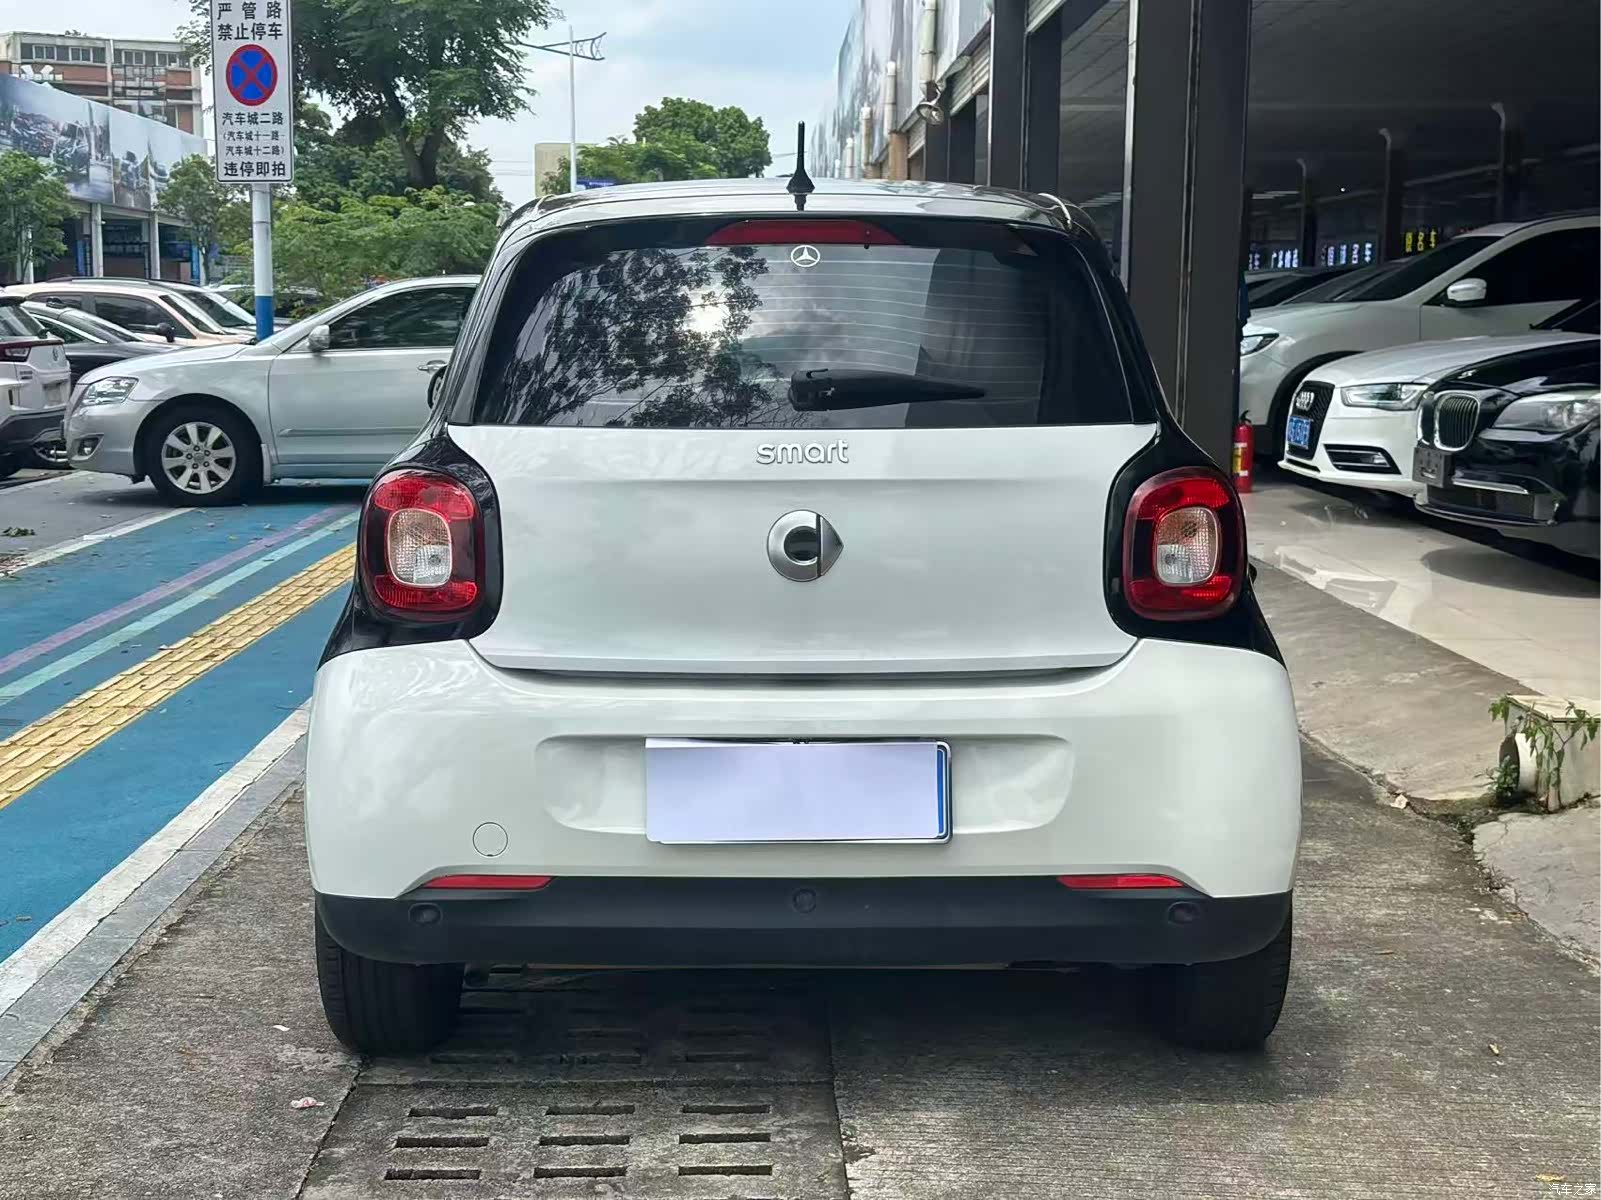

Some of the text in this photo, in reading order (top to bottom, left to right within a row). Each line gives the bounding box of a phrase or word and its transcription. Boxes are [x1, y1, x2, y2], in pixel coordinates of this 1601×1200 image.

[217, 1, 282, 20] 严管路
[217, 22, 283, 41] 禁止停车
[222, 112, 284, 126] 汽车城二路
[224, 161, 286, 177] 违停即拍
[756, 439, 849, 465] smart
